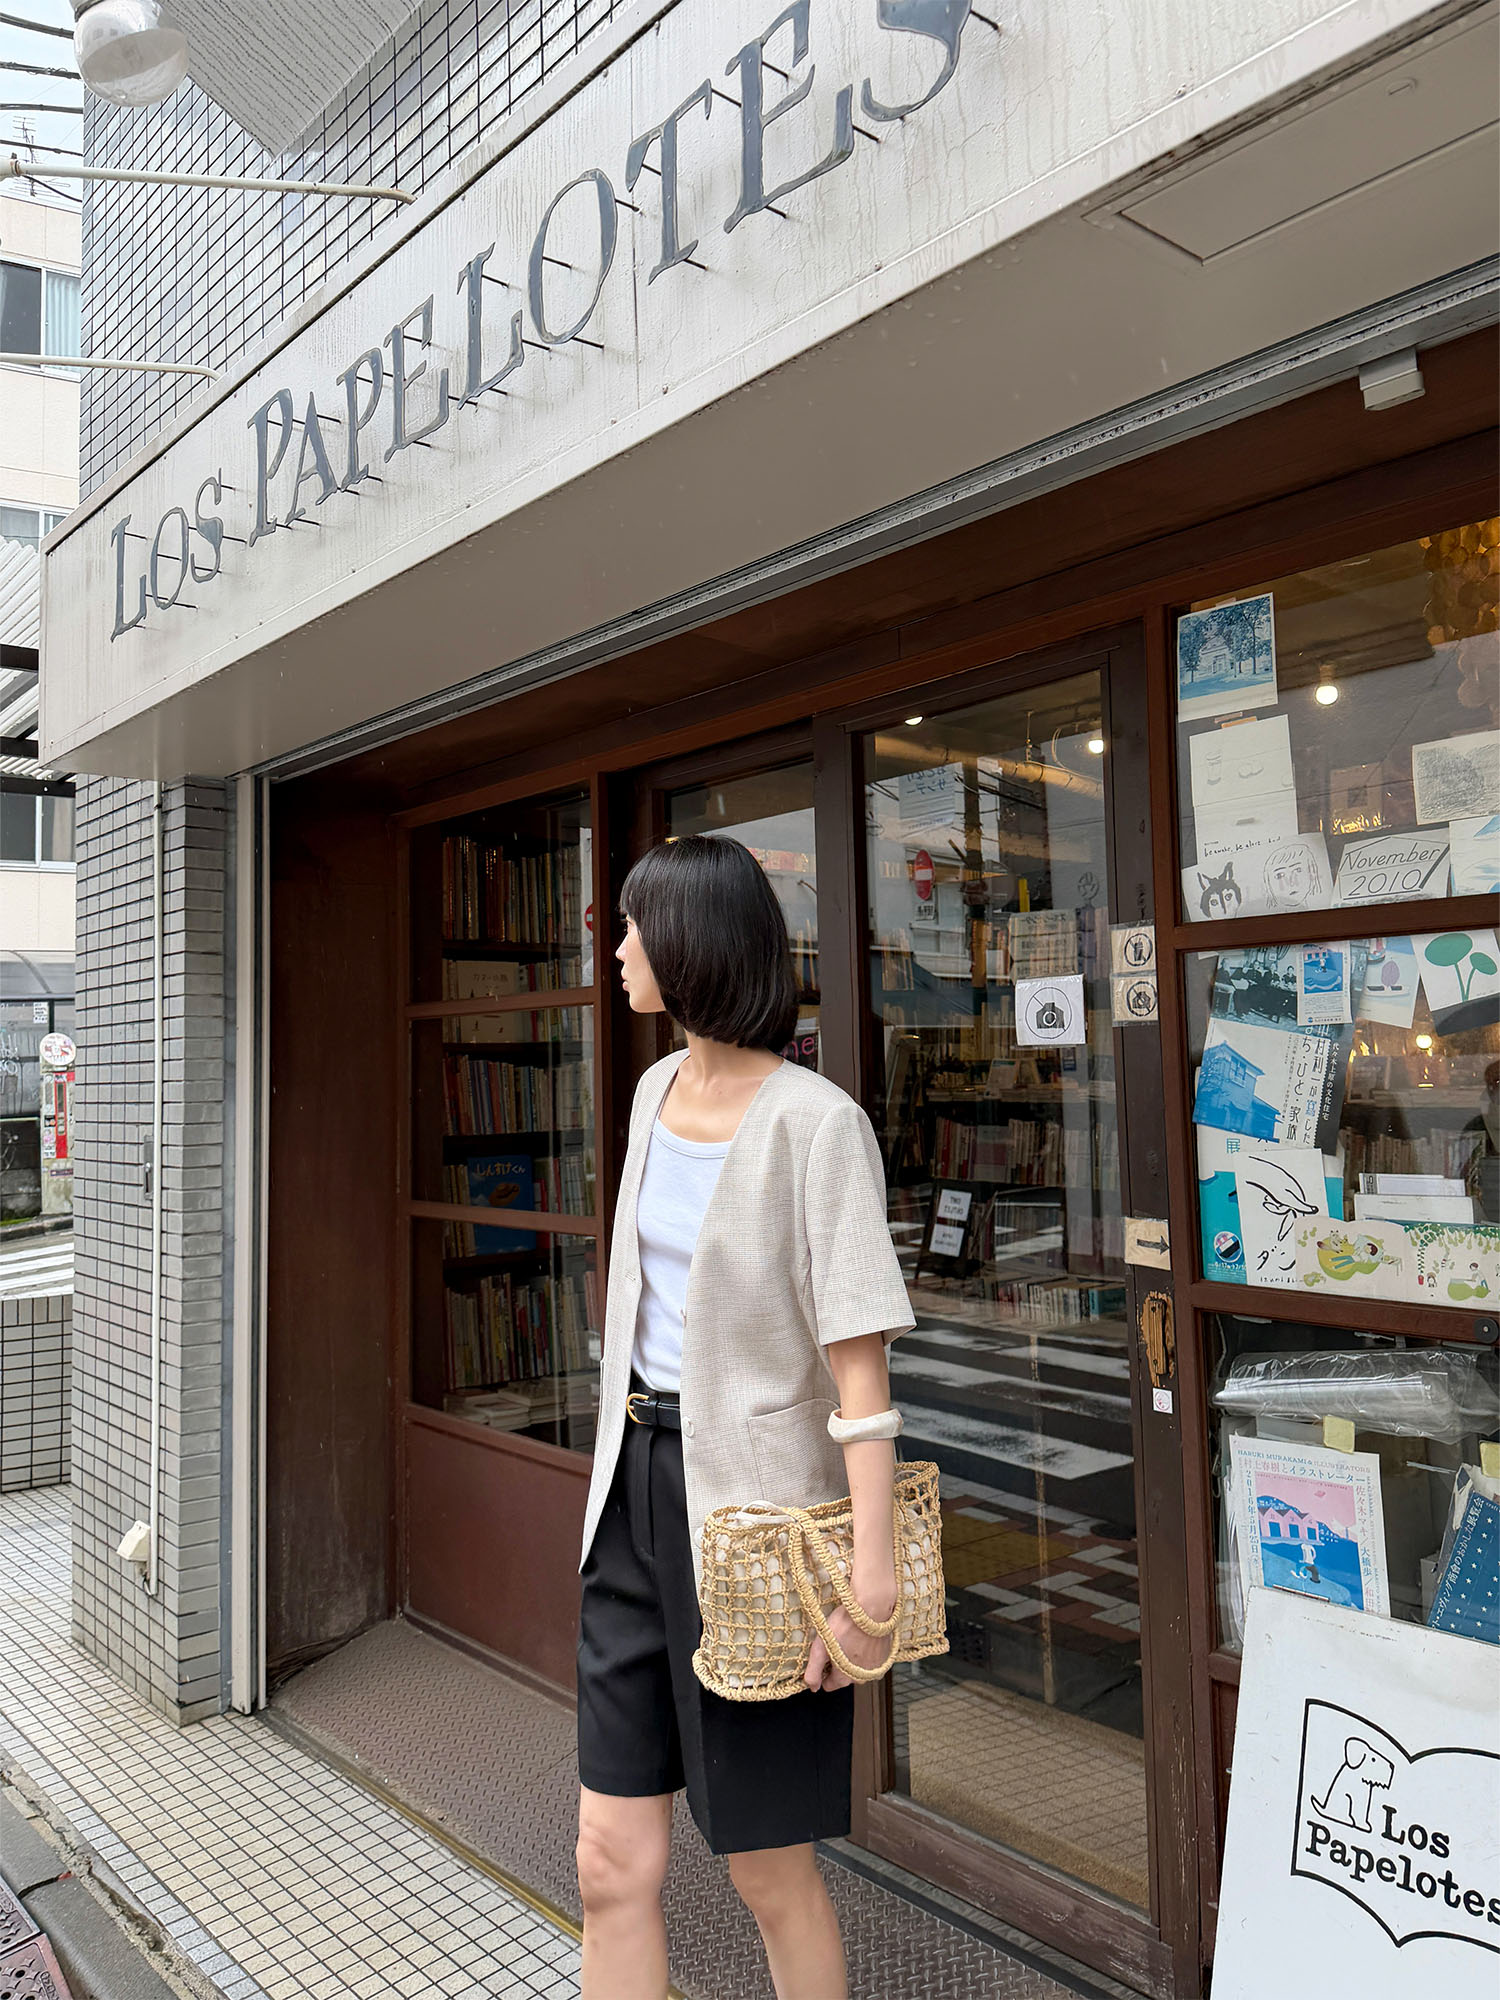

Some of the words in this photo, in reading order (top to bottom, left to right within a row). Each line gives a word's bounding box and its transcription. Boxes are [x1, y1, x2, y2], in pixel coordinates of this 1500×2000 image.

[111, 468, 223, 643] LOS
[1339, 842, 1441, 871] November
[1348, 868, 1422, 896] 2010
[1226, 1138, 1241, 1154] 展
[1237, 1449, 1265, 1459] HARUKI
[1266, 1453, 1307, 1465] MURAKAMI
[1244, 1458, 1366, 1483] 村上春樹とイラストレーター
[1381, 1804, 1451, 1859] Los
[1306, 1820, 1500, 1925] Papelotes
